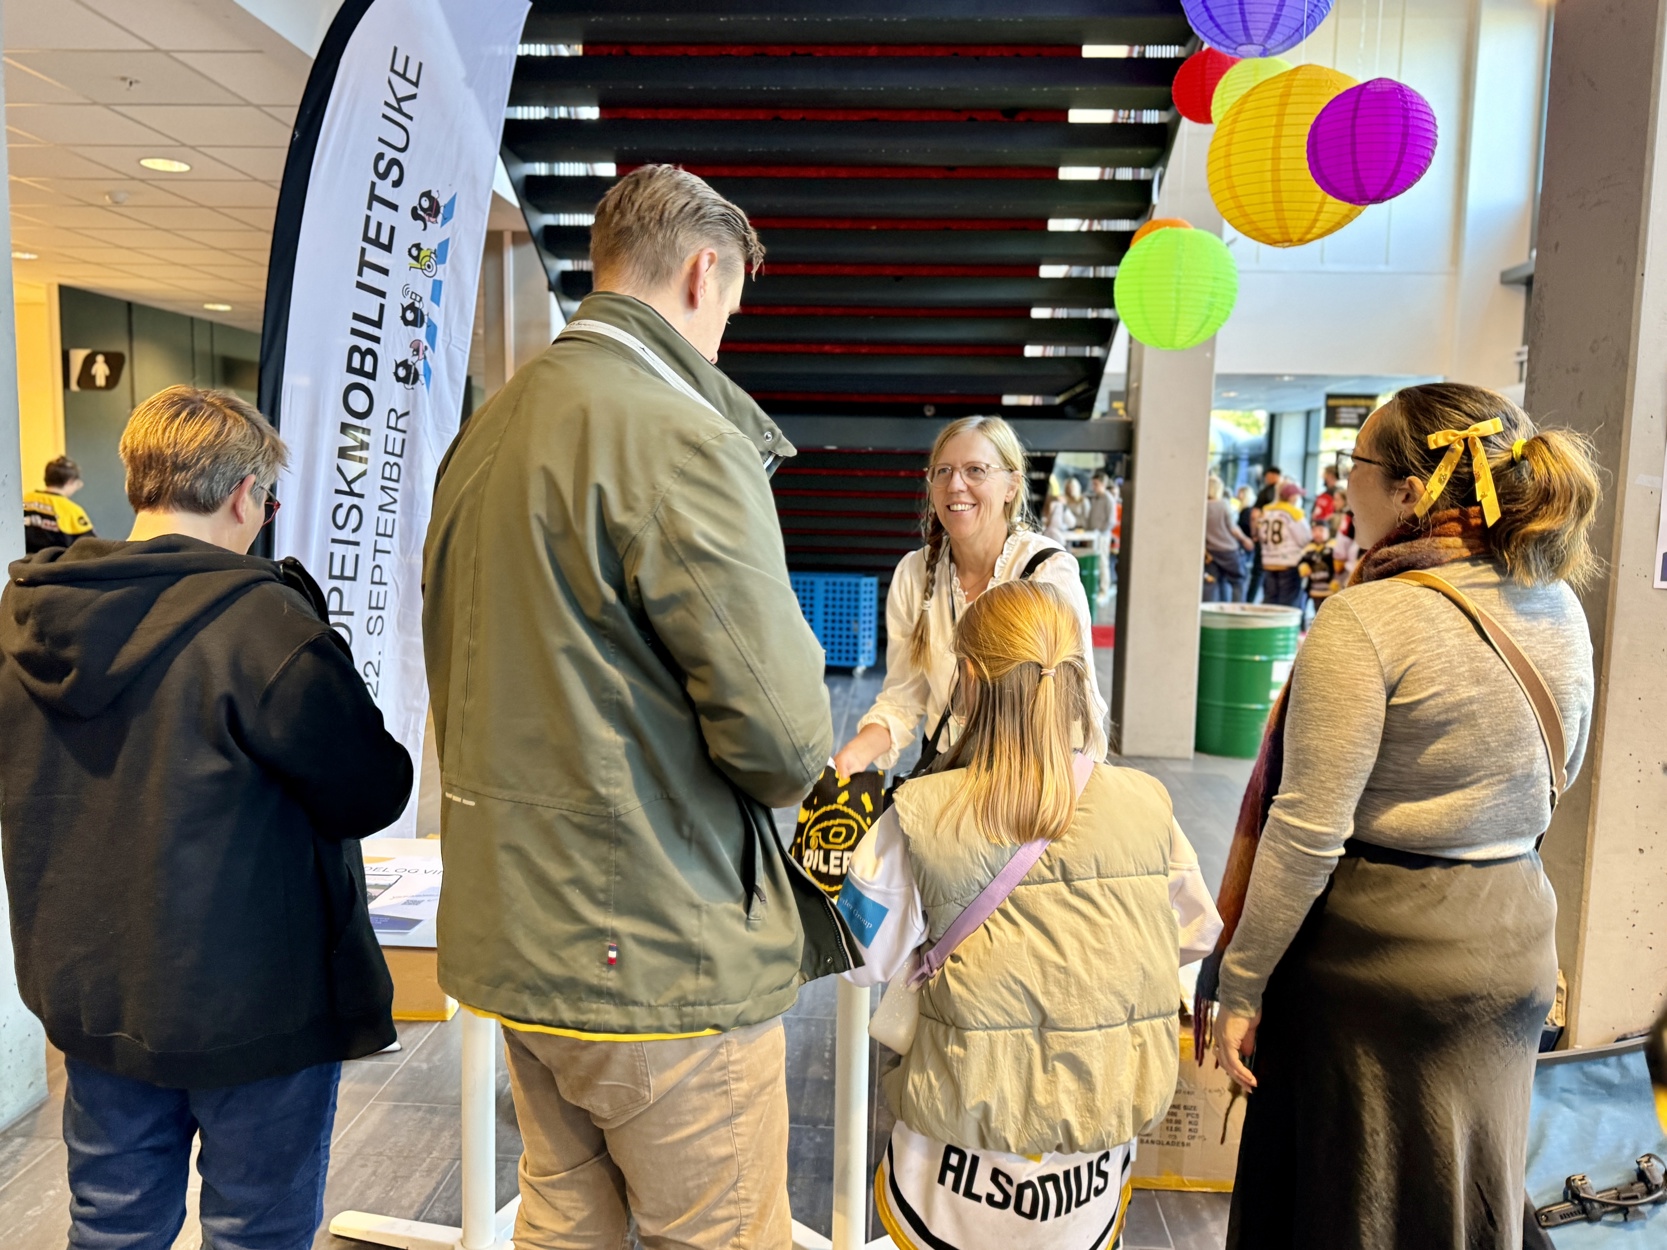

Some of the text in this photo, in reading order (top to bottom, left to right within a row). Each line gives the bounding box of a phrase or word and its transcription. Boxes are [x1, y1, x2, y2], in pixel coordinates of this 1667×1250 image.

[366, 407, 410, 636] SEPTEMBER
[1139, 1139, 1191, 1147] BANGLADESH
[937, 1144, 1111, 1222] ALSONIUS
